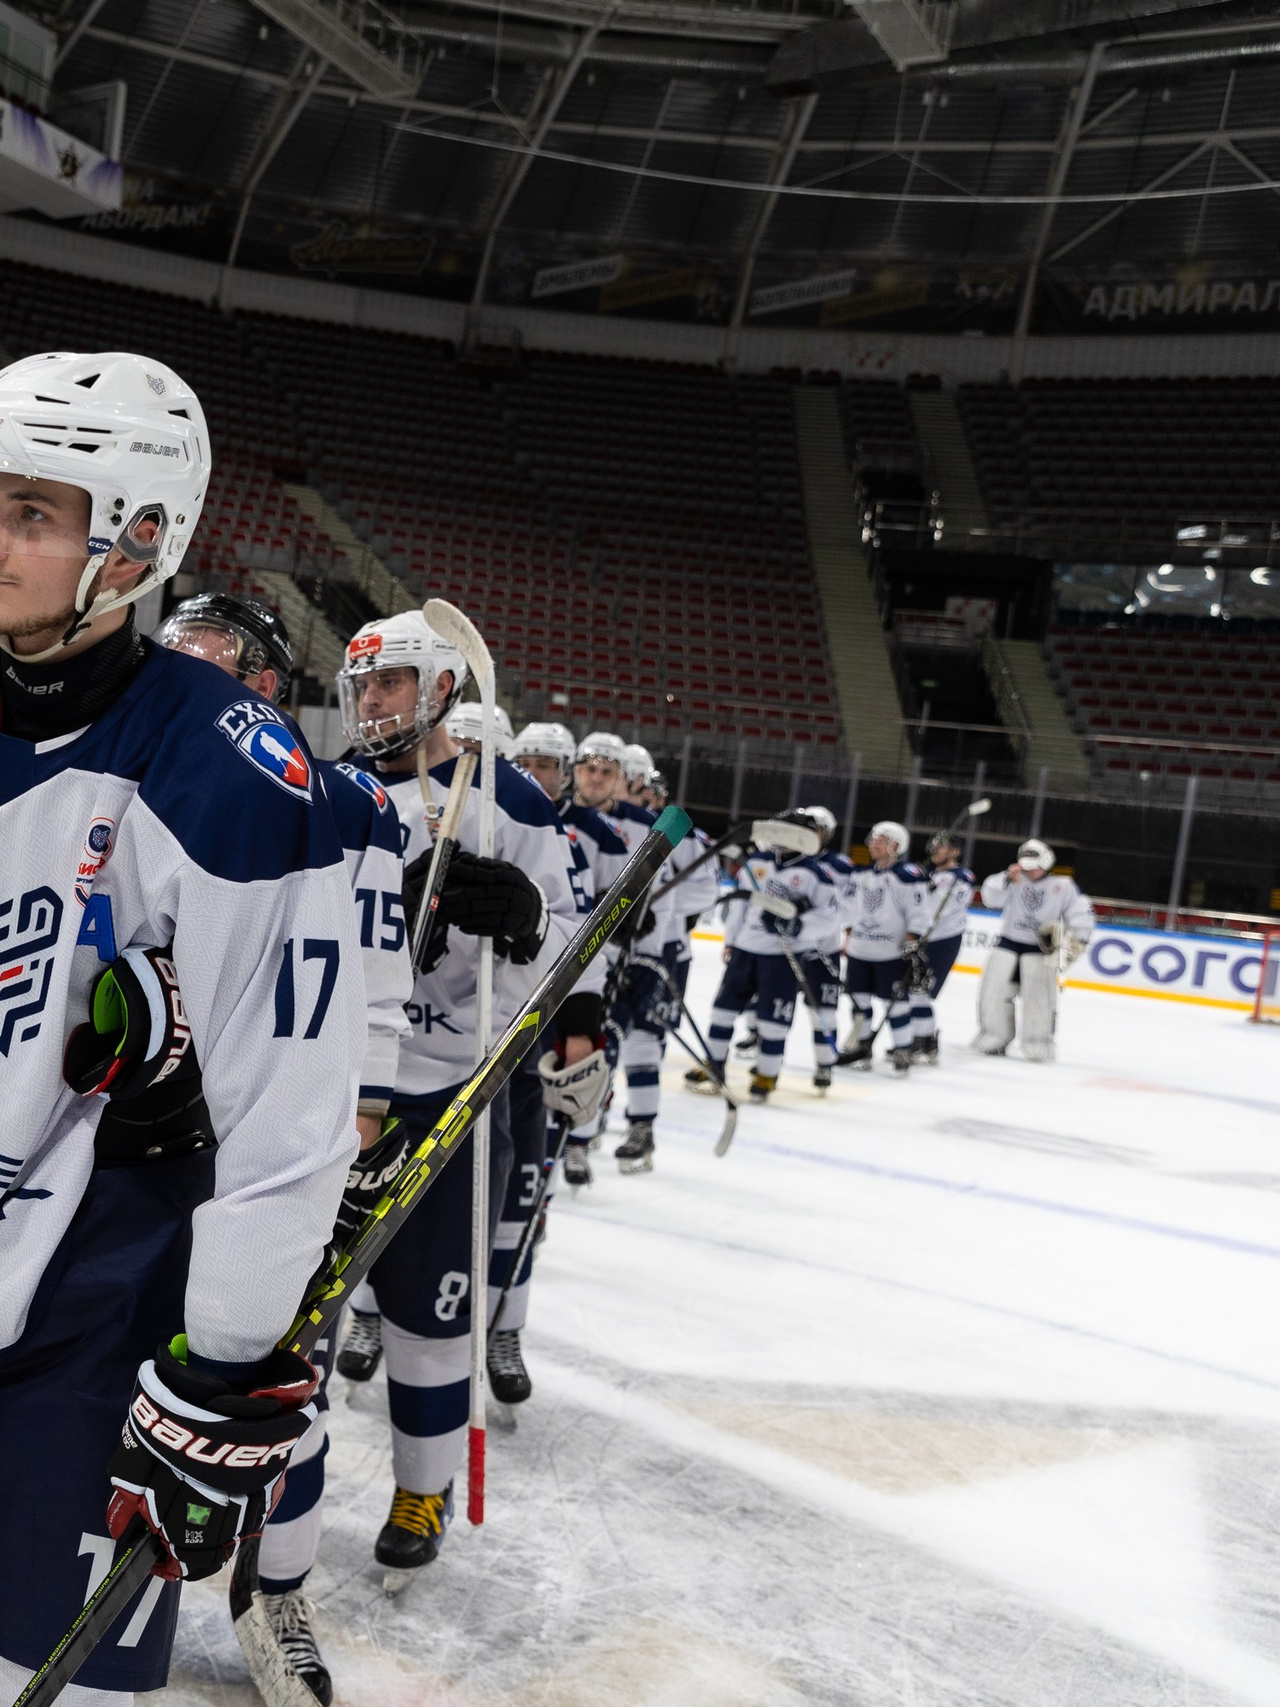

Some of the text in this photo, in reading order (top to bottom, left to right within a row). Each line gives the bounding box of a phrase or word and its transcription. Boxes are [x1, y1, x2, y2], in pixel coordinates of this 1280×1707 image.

[1082, 280, 1280, 322] АДМИРАЛ
[129, 441, 180, 459] BAUER
[88, 540, 111, 551] CCM
[354, 888, 405, 952] 15
[580, 903, 622, 965] BAUER
[272, 938, 340, 1040] 17
[434, 1270, 469, 1322] 8
[131, 1393, 299, 1467] BAUER
[108, 1547, 132, 1578] DYNAMIC
[93, 1577, 111, 1598] QUICK
